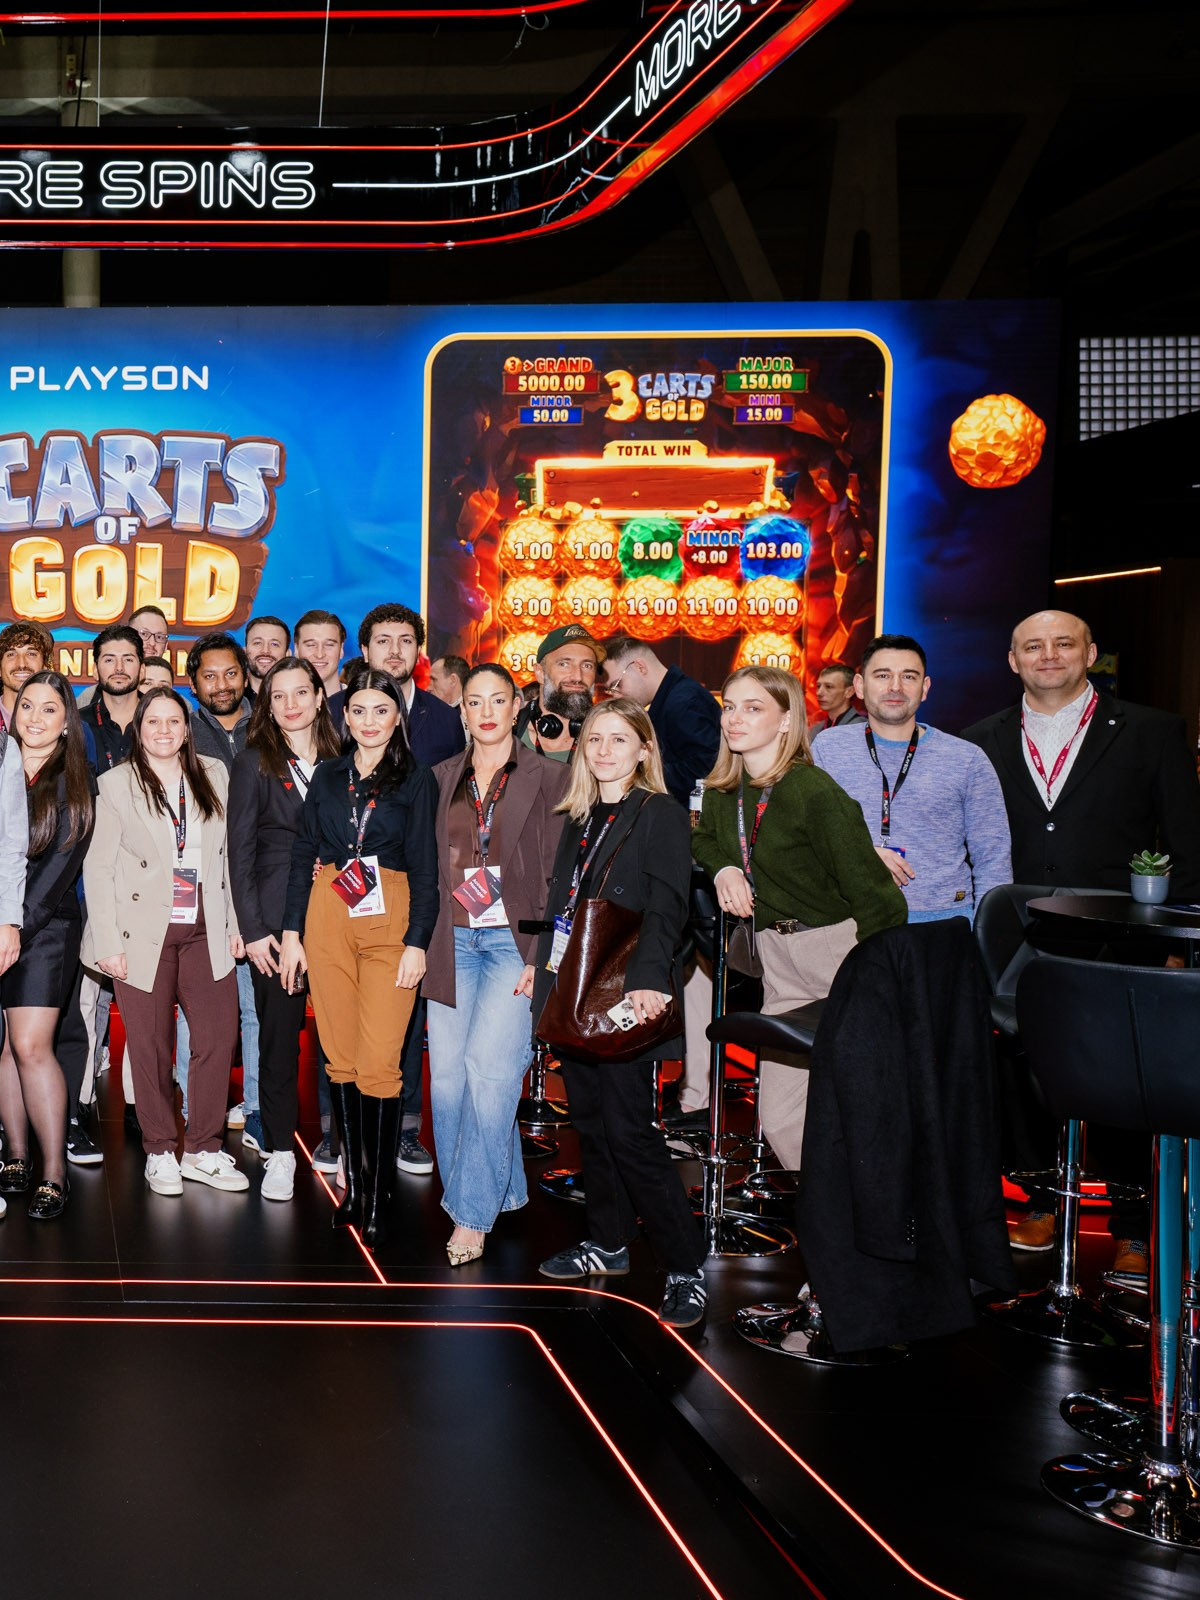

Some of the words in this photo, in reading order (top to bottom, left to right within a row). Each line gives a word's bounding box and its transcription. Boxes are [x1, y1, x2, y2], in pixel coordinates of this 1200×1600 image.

[635, 0, 742, 116] MORE
[100, 160, 316, 209] SPINS
[534, 357, 594, 373] GRAND
[739, 357, 794, 372] MAJOR
[10, 365, 209, 391] PLAYSON
[518, 374, 586, 392] 5000.00
[739, 373, 793, 390] 150.00
[530, 395, 573, 408] MINOR
[603, 369, 643, 422] 3
[638, 373, 716, 399] CARTS
[667, 392, 680, 401] OF
[748, 394, 781, 406] MINI
[532, 408, 570, 423] 50.00
[645, 398, 705, 422] GOLD
[746, 407, 783, 422] 15.00
[617, 445, 657, 457] TOTAL
[663, 445, 692, 456] WIN
[94, 515, 140, 544] OF
[686, 530, 742, 548] MINOR
[514, 542, 553, 560] 1.00
[574, 542, 613, 560] 1.00
[632, 541, 674, 560] 8.00
[691, 550, 728, 565] +8.00
[746, 542, 803, 559] 103.00
[9, 536, 241, 628] GOLD
[512, 598, 552, 616] 3.00
[572, 598, 612, 616] 3.00
[626, 598, 678, 616] 16.00
[686, 598, 738, 616] 11.00
[746, 598, 798, 616] 10.00
[511, 654, 538, 672] 3.0
[901, 752, 913, 774] PLAYSON
[294, 765, 308, 784] PLAYSON
[492, 789, 500, 801] GET
[360, 810, 370, 833] PLAYSON
[485, 802, 495, 827] PLAYSON
